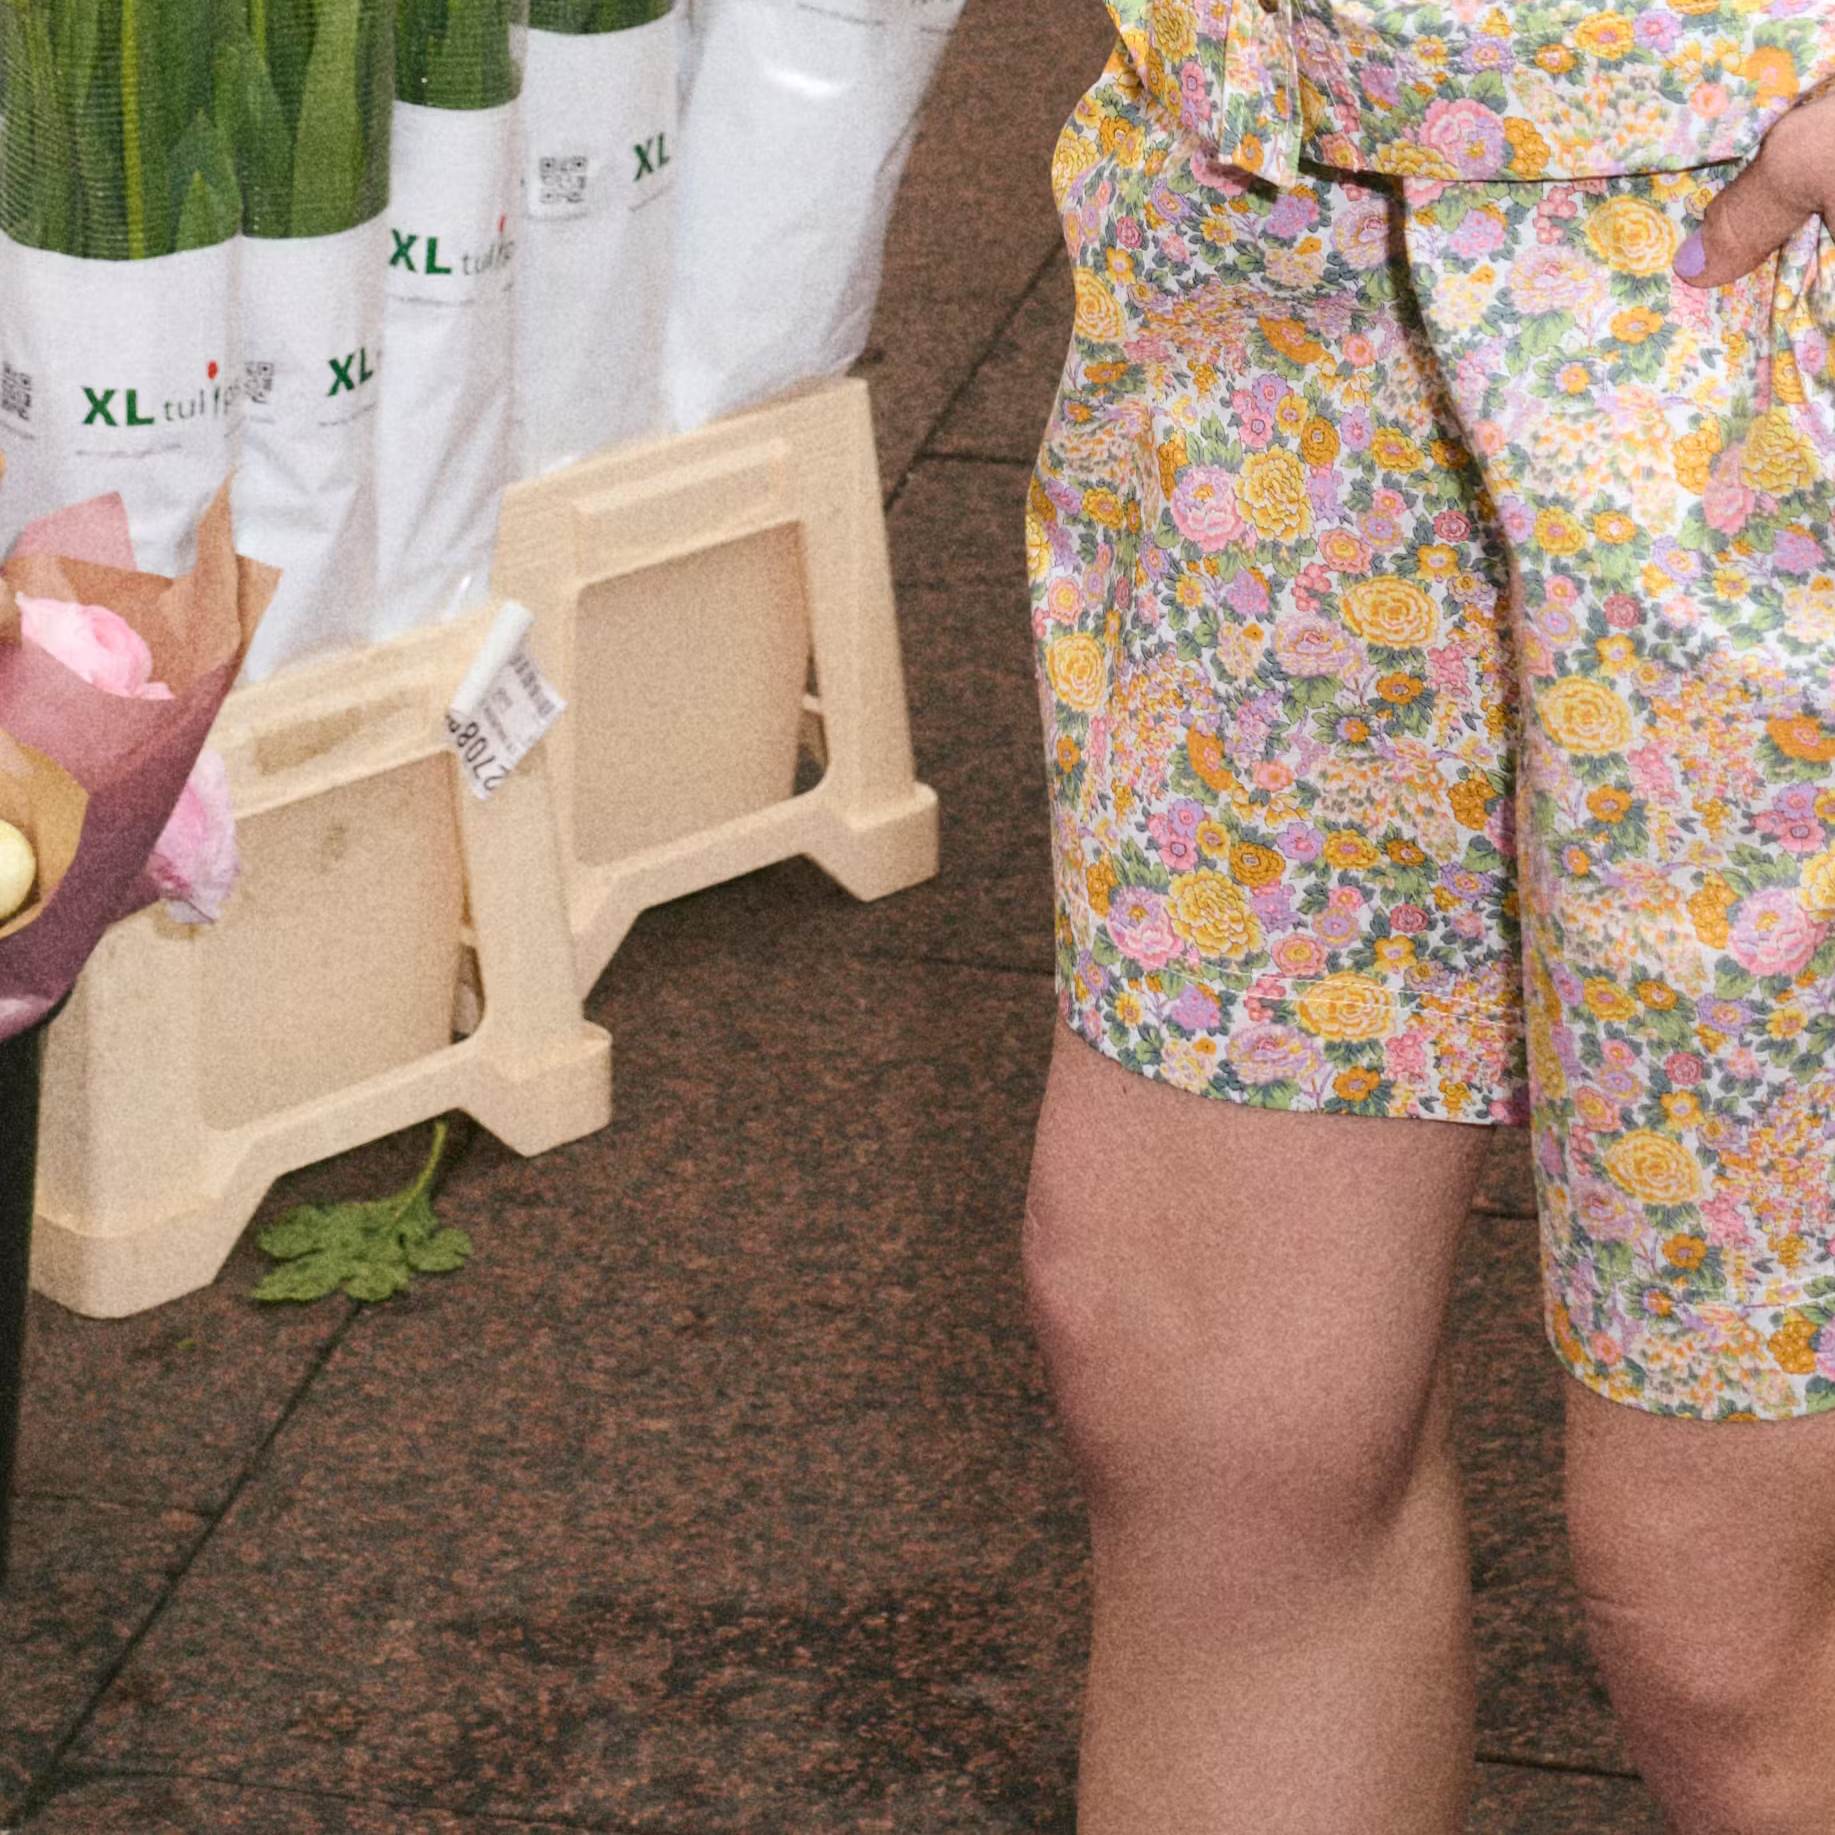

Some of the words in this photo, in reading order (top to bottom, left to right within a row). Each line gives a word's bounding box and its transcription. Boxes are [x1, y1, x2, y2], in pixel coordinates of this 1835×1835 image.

[633, 131, 671, 182] XL
[389, 228, 453, 275] XL
[326, 346, 374, 397] XL
[82, 386, 155, 427] XL
